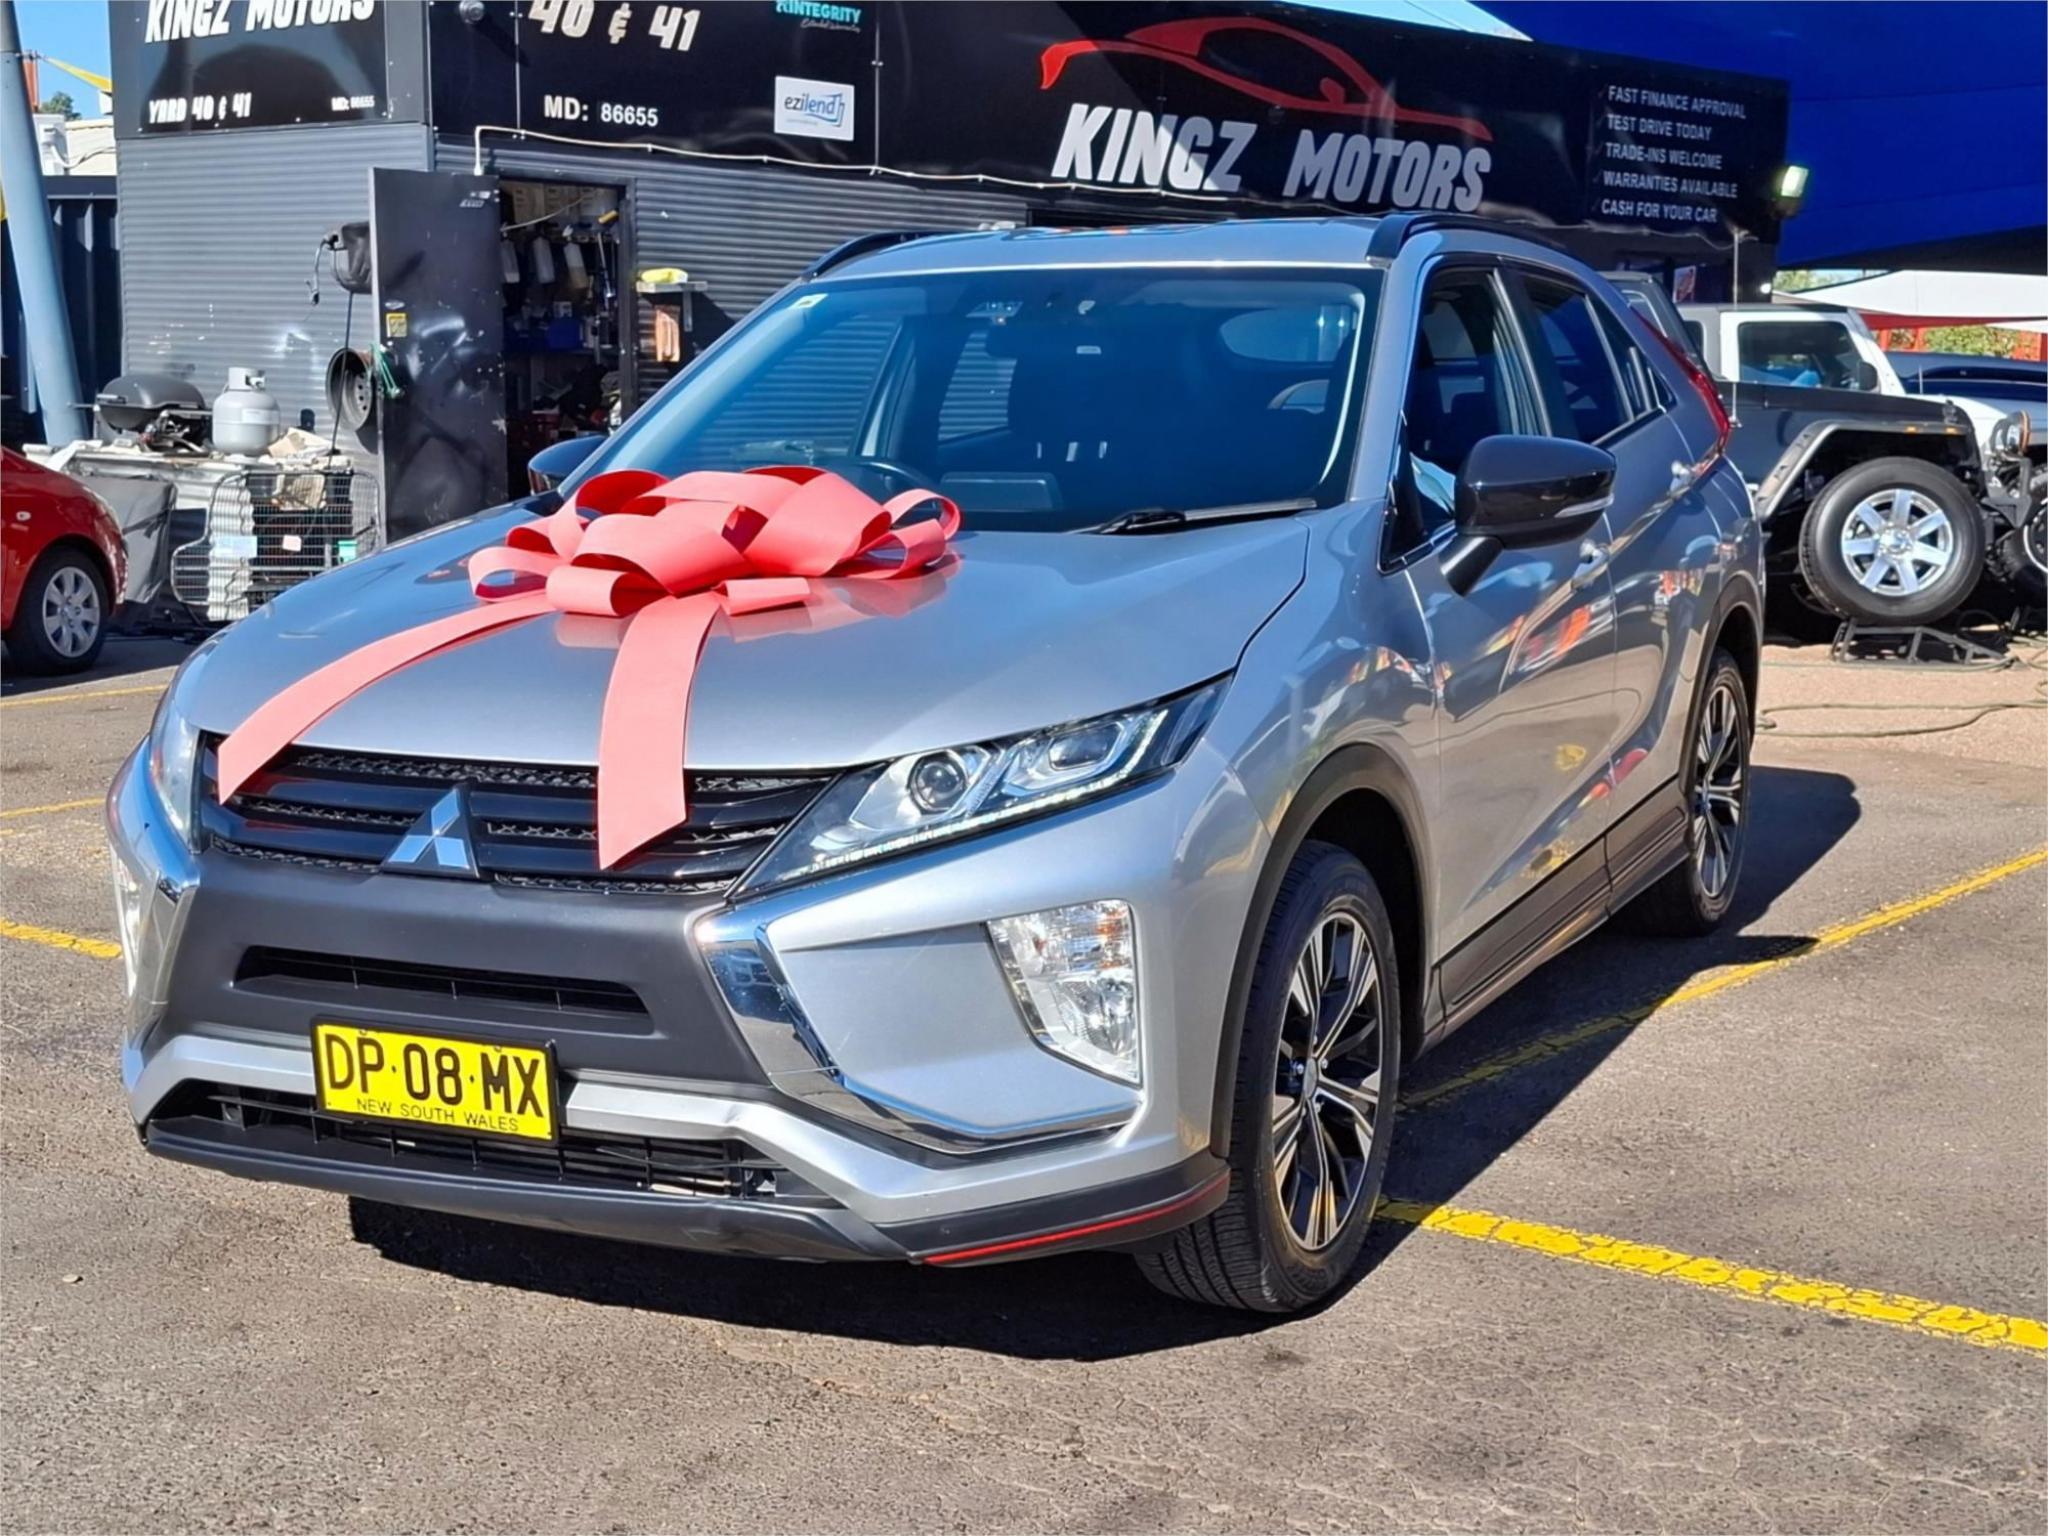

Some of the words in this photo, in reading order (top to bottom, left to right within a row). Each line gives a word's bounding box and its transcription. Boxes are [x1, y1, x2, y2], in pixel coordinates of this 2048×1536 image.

[144, 0, 230, 43] KINGZ
[528, 0, 595, 38] 40
[648, 6, 700, 51] 41
[148, 97, 187, 124] YARD
[192, 95, 214, 121] 40
[232, 92, 252, 118] 41
[543, 96, 589, 122] MD:
[600, 103, 658, 127] 86655
[784, 93, 838, 115] ezilend
[1608, 86, 1638, 103] FAST
[1640, 90, 1689, 111] FINANCE
[1691, 98, 1746, 119] APPROVAL
[1607, 113, 1637, 131] TEST
[1639, 118, 1673, 137] DRIVE
[1675, 123, 1712, 141] TODAY
[1051, 103, 1258, 193] KINGZ
[1282, 129, 1492, 213] MOTORS
[1605, 142, 1667, 164] TRADE-INS
[1669, 149, 1723, 170] WELCOME
[1603, 170, 1678, 193] WARRANTIES
[1680, 178, 1738, 198] AVAILABLE
[1601, 199, 1634, 216] CASH
[1636, 202, 1660, 218] FOR
[1663, 204, 1693, 221] YOUR
[1694, 207, 1718, 223] CAR
[356, 1097, 392, 1114] NEW
[400, 1104, 455, 1123] SOUTH
[463, 1111, 519, 1132] WALES
